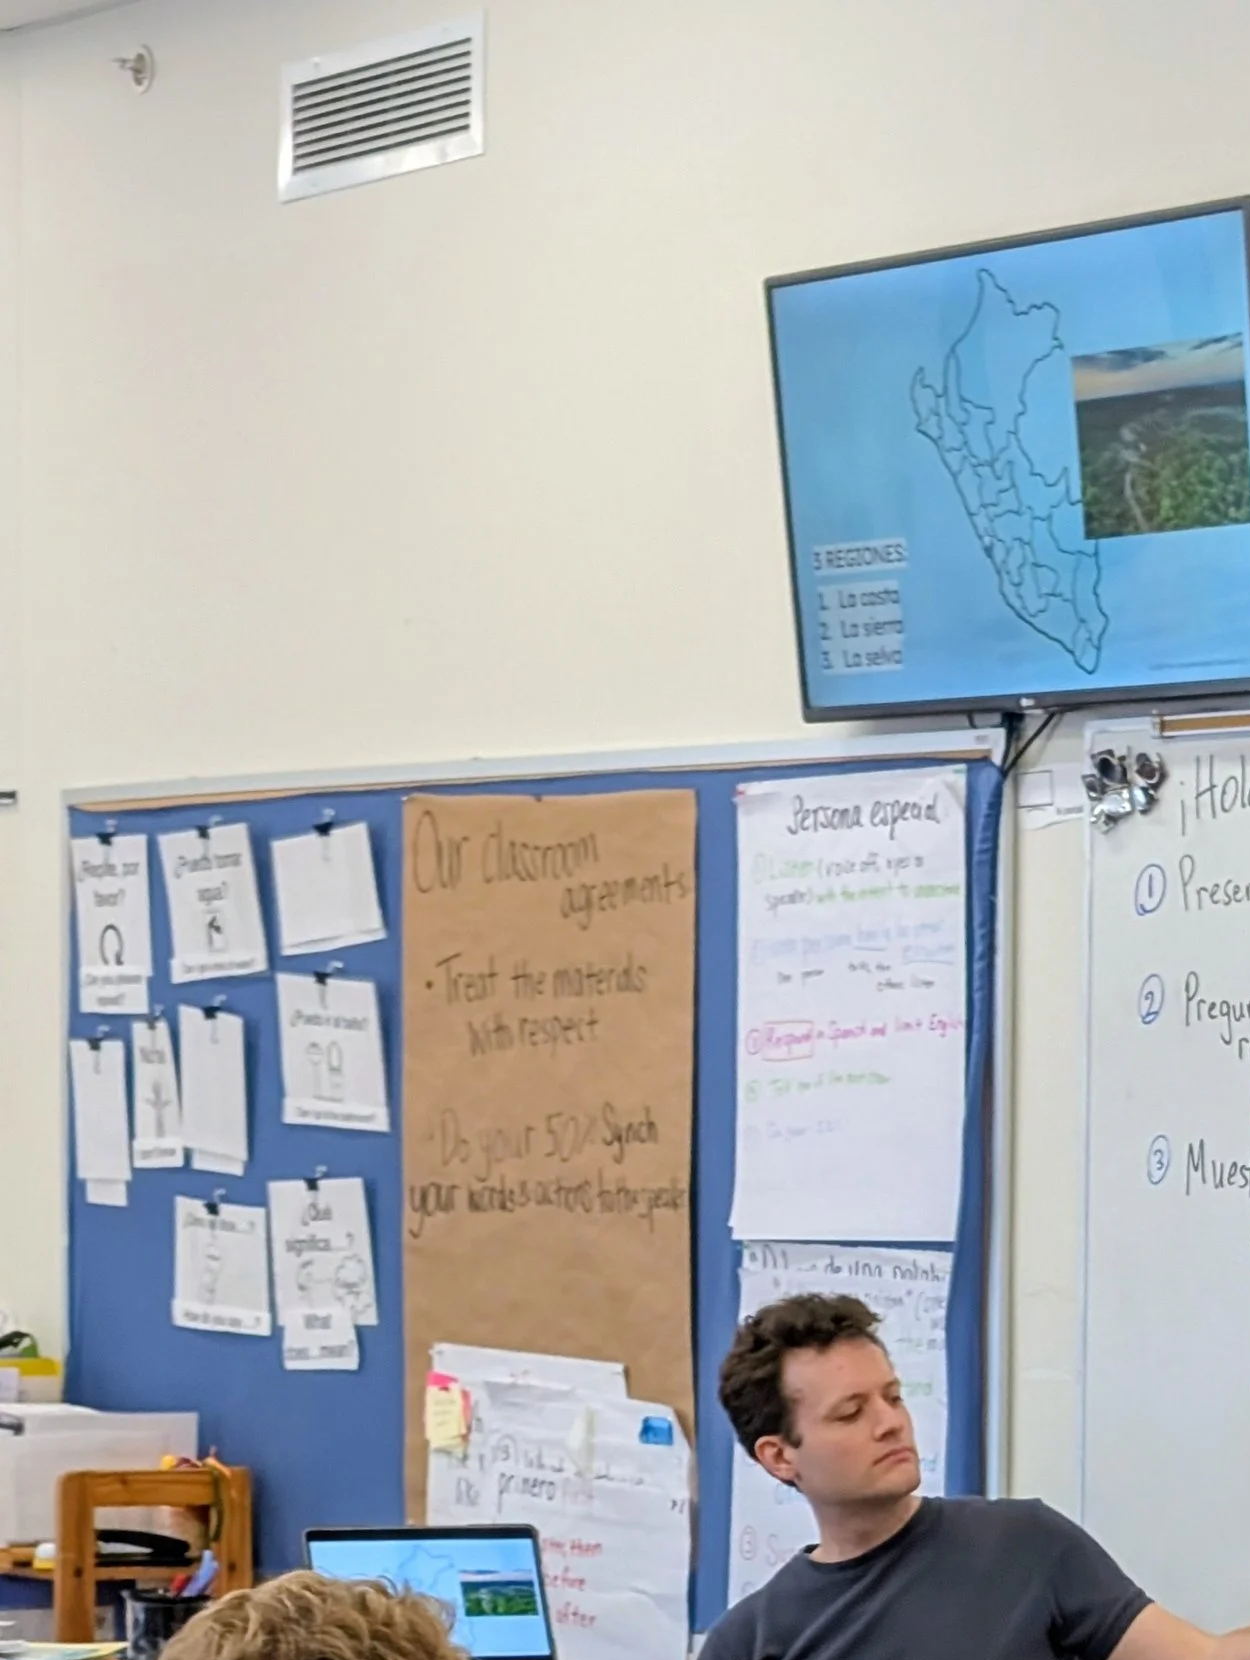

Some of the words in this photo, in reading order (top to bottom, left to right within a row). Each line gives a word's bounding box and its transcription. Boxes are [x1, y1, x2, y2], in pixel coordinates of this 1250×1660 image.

[787, 794, 863, 836] Persona
[869, 794, 941, 840] especial
[412, 810, 470, 894] Our
[481, 819, 599, 884] classroom
[560, 862, 690, 931] agreements
[434, 952, 500, 1006] Treat
[511, 958, 545, 999] the
[468, 1010, 514, 1059] with
[519, 1007, 600, 1058] respect
[408, 1180, 461, 1239] your
